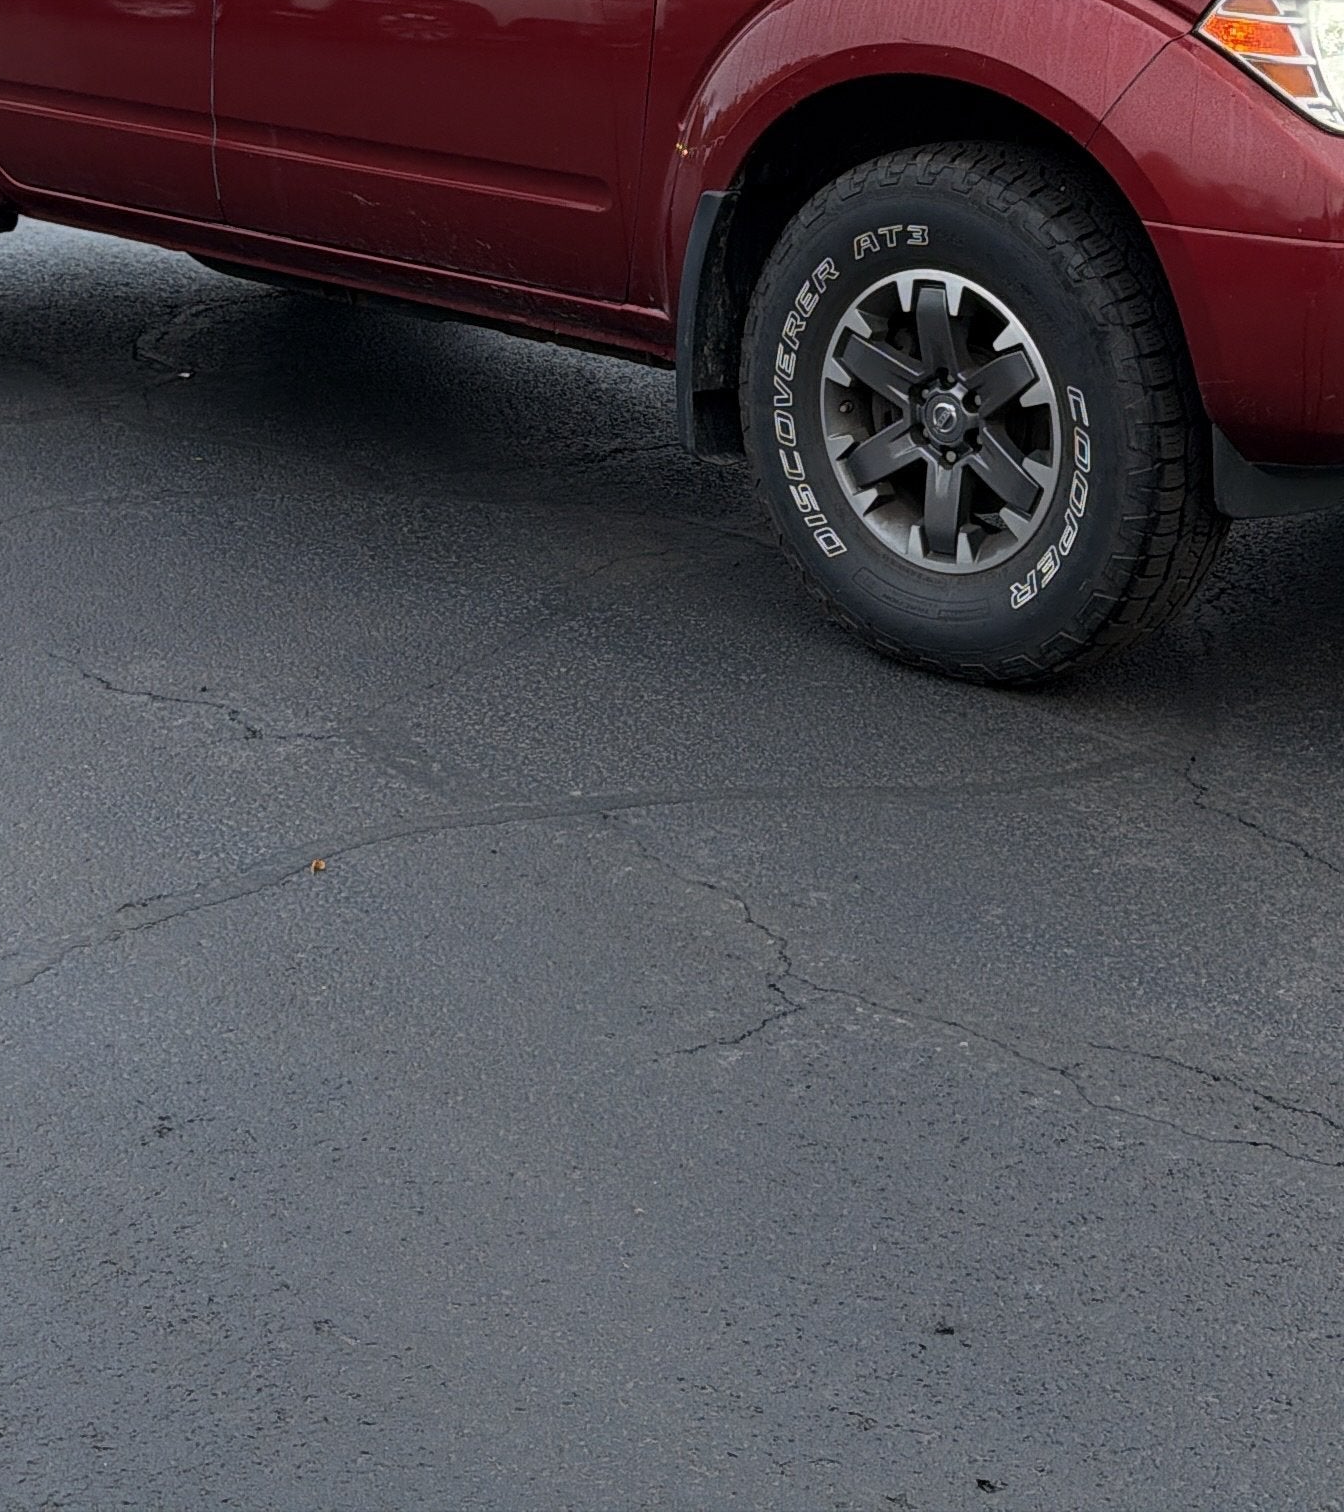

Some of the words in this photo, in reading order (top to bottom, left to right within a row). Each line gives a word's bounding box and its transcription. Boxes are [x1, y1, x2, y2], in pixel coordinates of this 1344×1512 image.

[773, 257, 848, 558] DISCOVERER
[853, 224, 929, 261] AT3
[1009, 385, 1091, 610] COOPER
